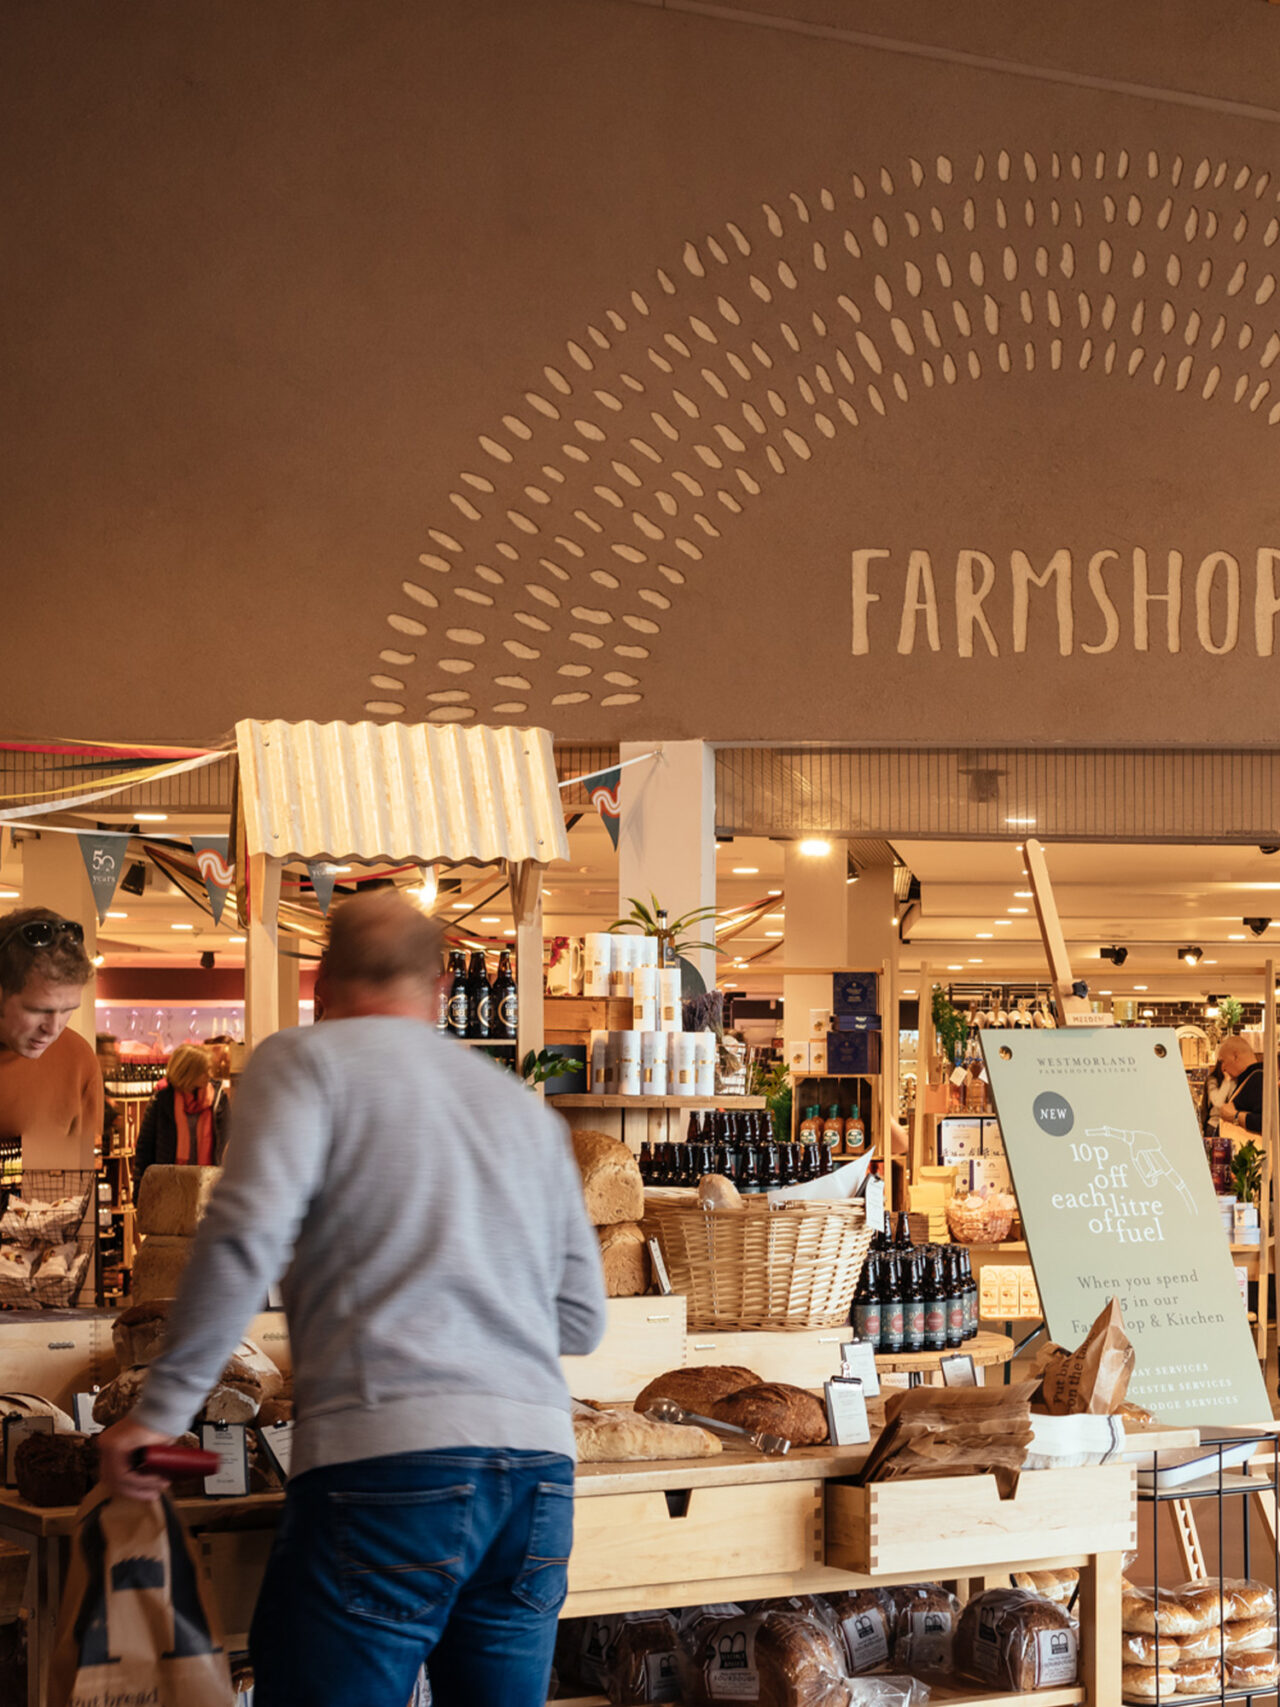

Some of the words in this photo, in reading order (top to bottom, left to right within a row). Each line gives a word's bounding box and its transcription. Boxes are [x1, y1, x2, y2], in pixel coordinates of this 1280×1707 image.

[92, 874, 116, 887] years
[1036, 1056, 1137, 1068] WESTMORLAND
[1039, 1108, 1068, 1120] NEW
[1069, 1142, 1110, 1170] 10p
[1094, 1163, 1129, 1190] off
[1051, 1183, 1108, 1209] each
[1109, 1193, 1164, 1218] litre
[1088, 1208, 1114, 1234] of
[1116, 1217, 1165, 1243] fuel
[1077, 1275, 1121, 1289] When
[1125, 1277, 1151, 1291] you
[1156, 1269, 1199, 1289] spend
[1134, 1296, 1149, 1308] in
[1153, 1295, 1179, 1307] our
[1150, 1314, 1161, 1328] &
[1166, 1311, 1225, 1327] Kitchen
[1067, 1363, 1083, 1385] the
[1155, 1362, 1209, 1376] SERVICES
[1178, 1378, 1233, 1392] SERVICES
[1185, 1395, 1240, 1408] SERVICES
